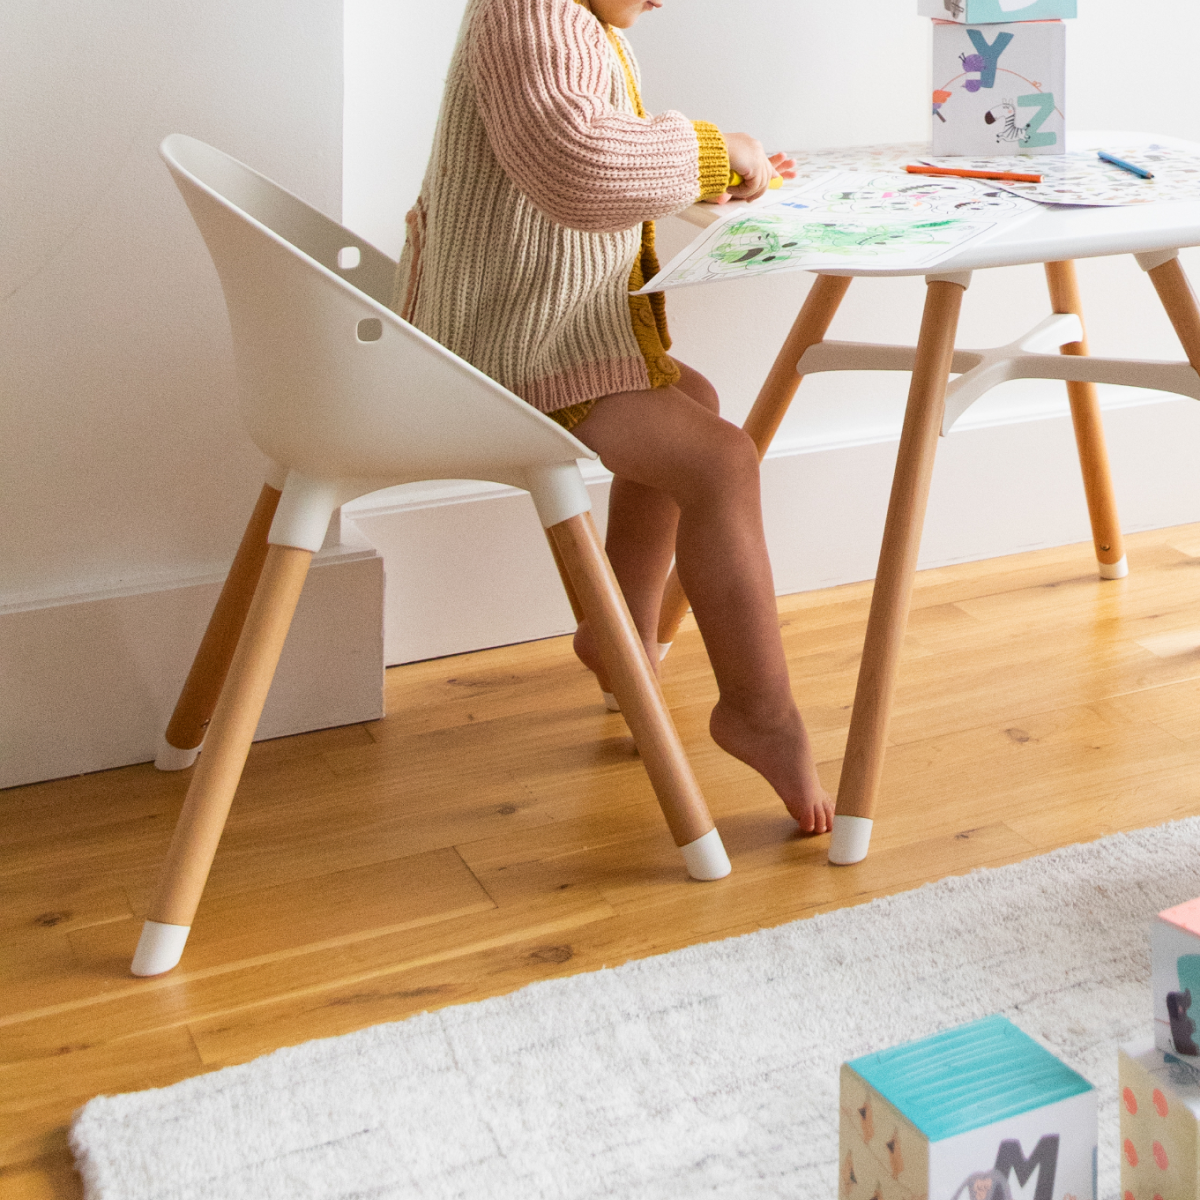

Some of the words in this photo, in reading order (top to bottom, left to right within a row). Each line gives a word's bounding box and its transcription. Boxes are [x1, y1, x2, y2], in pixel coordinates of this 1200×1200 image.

[966, 29, 1014, 88] Y
[1017, 92, 1057, 148] Z
[993, 1133, 1060, 1200] M
